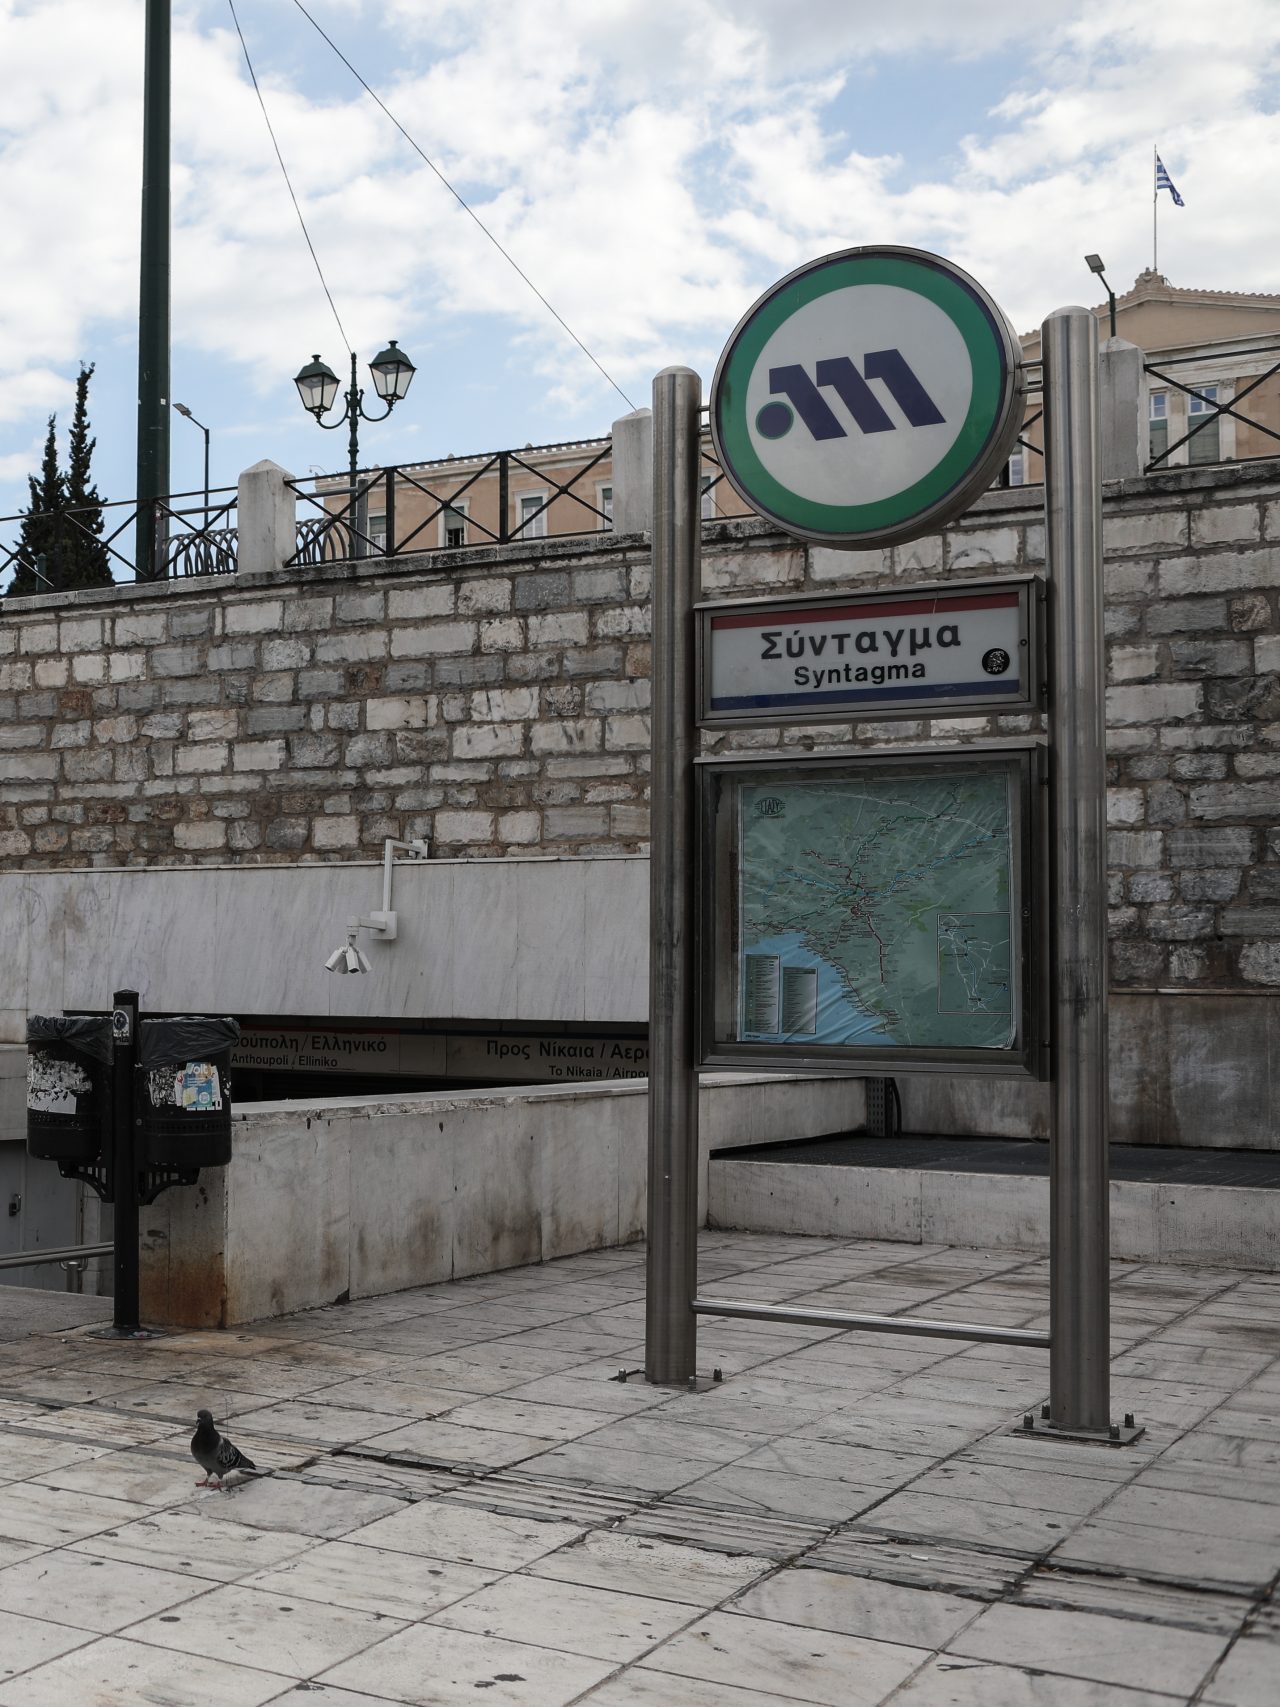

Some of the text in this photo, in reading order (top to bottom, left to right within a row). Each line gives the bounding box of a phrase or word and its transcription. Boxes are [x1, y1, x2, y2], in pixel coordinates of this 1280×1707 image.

[760, 623, 961, 660] Σύνταγμα
[794, 662, 927, 689] Syntagma
[312, 1033, 387, 1053] Ελληνικό
[487, 1040, 531, 1060] Προς
[539, 1041, 595, 1058] Νίκαια
[231, 1053, 289, 1066] Anthoupoli
[299, 1056, 338, 1068] Elliniko
[548, 1065, 563, 1076] To
[566, 1066, 602, 1078] Nikaia
